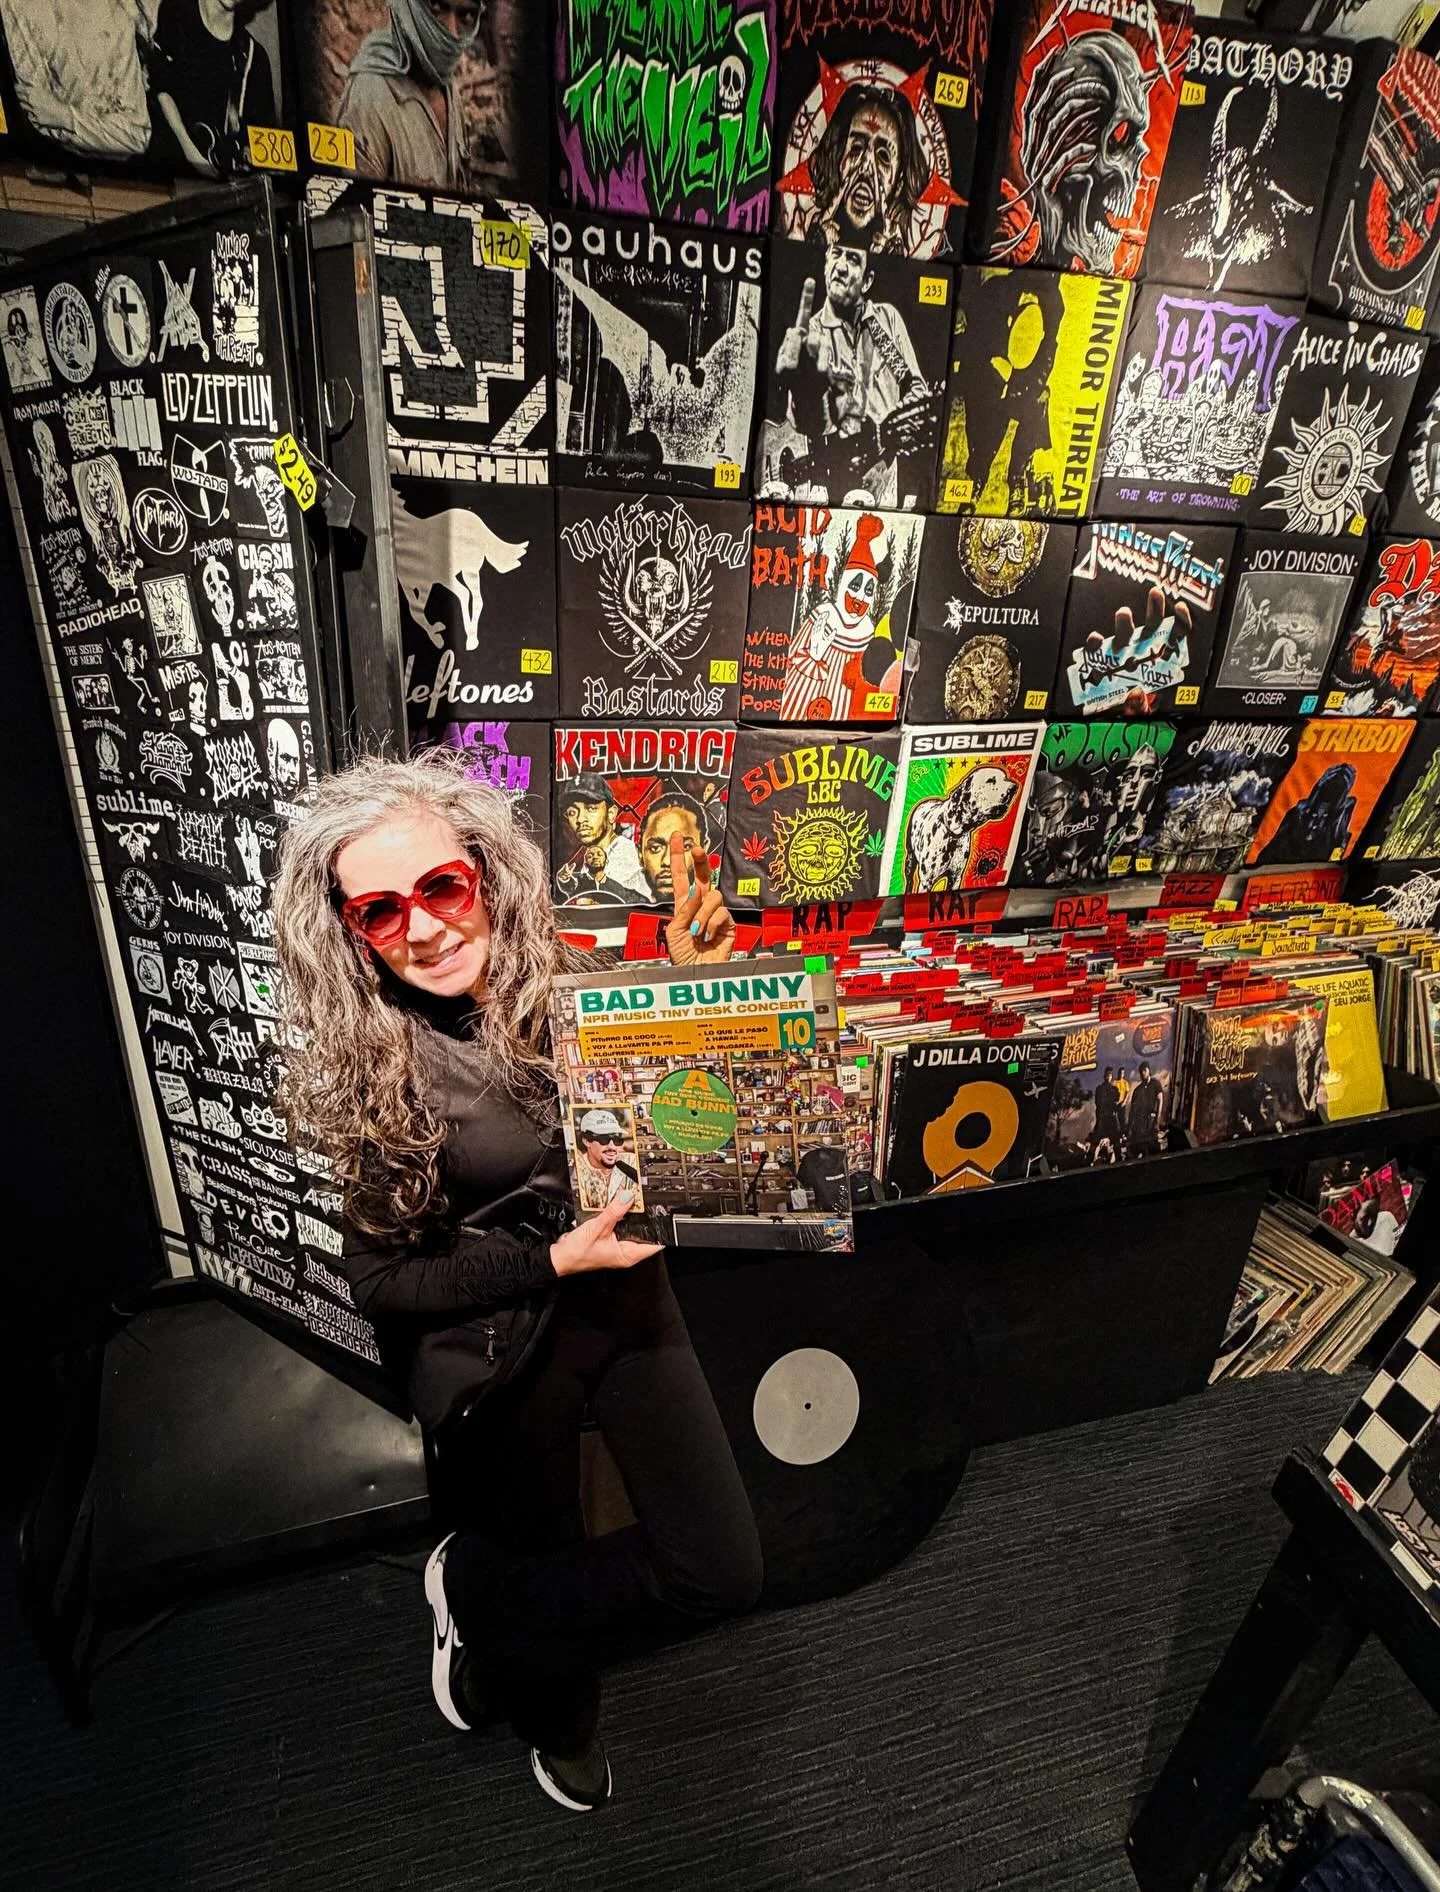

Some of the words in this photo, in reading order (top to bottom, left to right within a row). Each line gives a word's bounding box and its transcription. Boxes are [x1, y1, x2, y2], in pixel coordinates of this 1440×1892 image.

[1185, 34, 1352, 102] BATHORY
[938, 78, 964, 102] 269
[254, 135, 294, 162] 380
[313, 138, 350, 165] 231
[215, 229, 250, 264] MINOR
[484, 230, 521, 262] 470
[551, 222, 762, 279] bauhaus
[925, 284, 942, 297] 233
[212, 333, 260, 368] THREAT
[1290, 327, 1340, 371] ALICE
[109, 378, 146, 397] BLACK
[13, 404, 33, 422] IRON
[30, 399, 62, 419] MAIDEN
[137, 450, 164, 467] FLAG
[172, 465, 228, 492] WU-TANG
[719, 468, 736, 482] 193
[949, 486, 967, 501] 462
[754, 504, 832, 536] ACID
[238, 542, 294, 571] CASH
[751, 544, 829, 592] BATH
[1249, 550, 1284, 572] JOY
[1284, 550, 1353, 574] DIVISION
[58, 597, 141, 639] RADIOHEAD
[63, 645, 77, 657] THE
[78, 643, 104, 656] SISTERS
[746, 631, 793, 649] WHEN
[69, 655, 79, 667] OF
[80, 654, 103, 667] MERCY
[523, 652, 550, 673] 432
[743, 649, 766, 669] THE
[158, 661, 202, 692] MISFITS
[712, 663, 736, 680] 218
[581, 676, 726, 717] Bastards
[868, 696, 891, 710] 476
[1028, 694, 1043, 707] 217
[1178, 689, 1196, 702] 239
[1244, 693, 1285, 706] CLOSER
[913, 731, 1034, 753] SUBLIME
[1298, 721, 1407, 753] STARBOY
[741, 745, 897, 806] SUBLIME
[807, 781, 841, 803] LBC
[95, 789, 177, 821] sublime
[254, 820, 277, 837] IGGY
[259, 836, 277, 850] POP
[742, 881, 757, 894] 126
[1165, 878, 1215, 896] JAZZ
[791, 901, 852, 938] RAP
[1056, 898, 1107, 928] RAP
[129, 935, 161, 951] GERMS
[164, 931, 182, 946] JOY
[183, 933, 232, 950] DIVISION
[580, 988, 656, 1014] BAD
[669, 974, 806, 1004] BUNNY
[1322, 982, 1337, 993] LIFE
[1339, 977, 1370, 990] AQUATIC
[583, 1012, 610, 1025] NPR
[613, 1009, 656, 1022] MUSIC
[660, 1006, 690, 1018] TINY
[693, 1004, 733, 1016] DESK
[736, 999, 808, 1014] CONCERT
[1333, 997, 1348, 1006] SEU
[1349, 994, 1372, 1005] JORGE
[782, 1017, 811, 1046] 10
[152, 1035, 196, 1074] SLAYER
[913, 1050, 926, 1067] J
[927, 1048, 982, 1066] DILLA
[683, 1069, 712, 1091] A
[177, 1125, 200, 1142] THE
[200, 1134, 236, 1155] CLASH
[243, 1137, 296, 1168] SIOUXSIE
[260, 1178, 301, 1205] BANSHEES
[252, 1281, 308, 1319] ANTI-FLAG
[308, 1316, 382, 1366] DESCENDENTS
